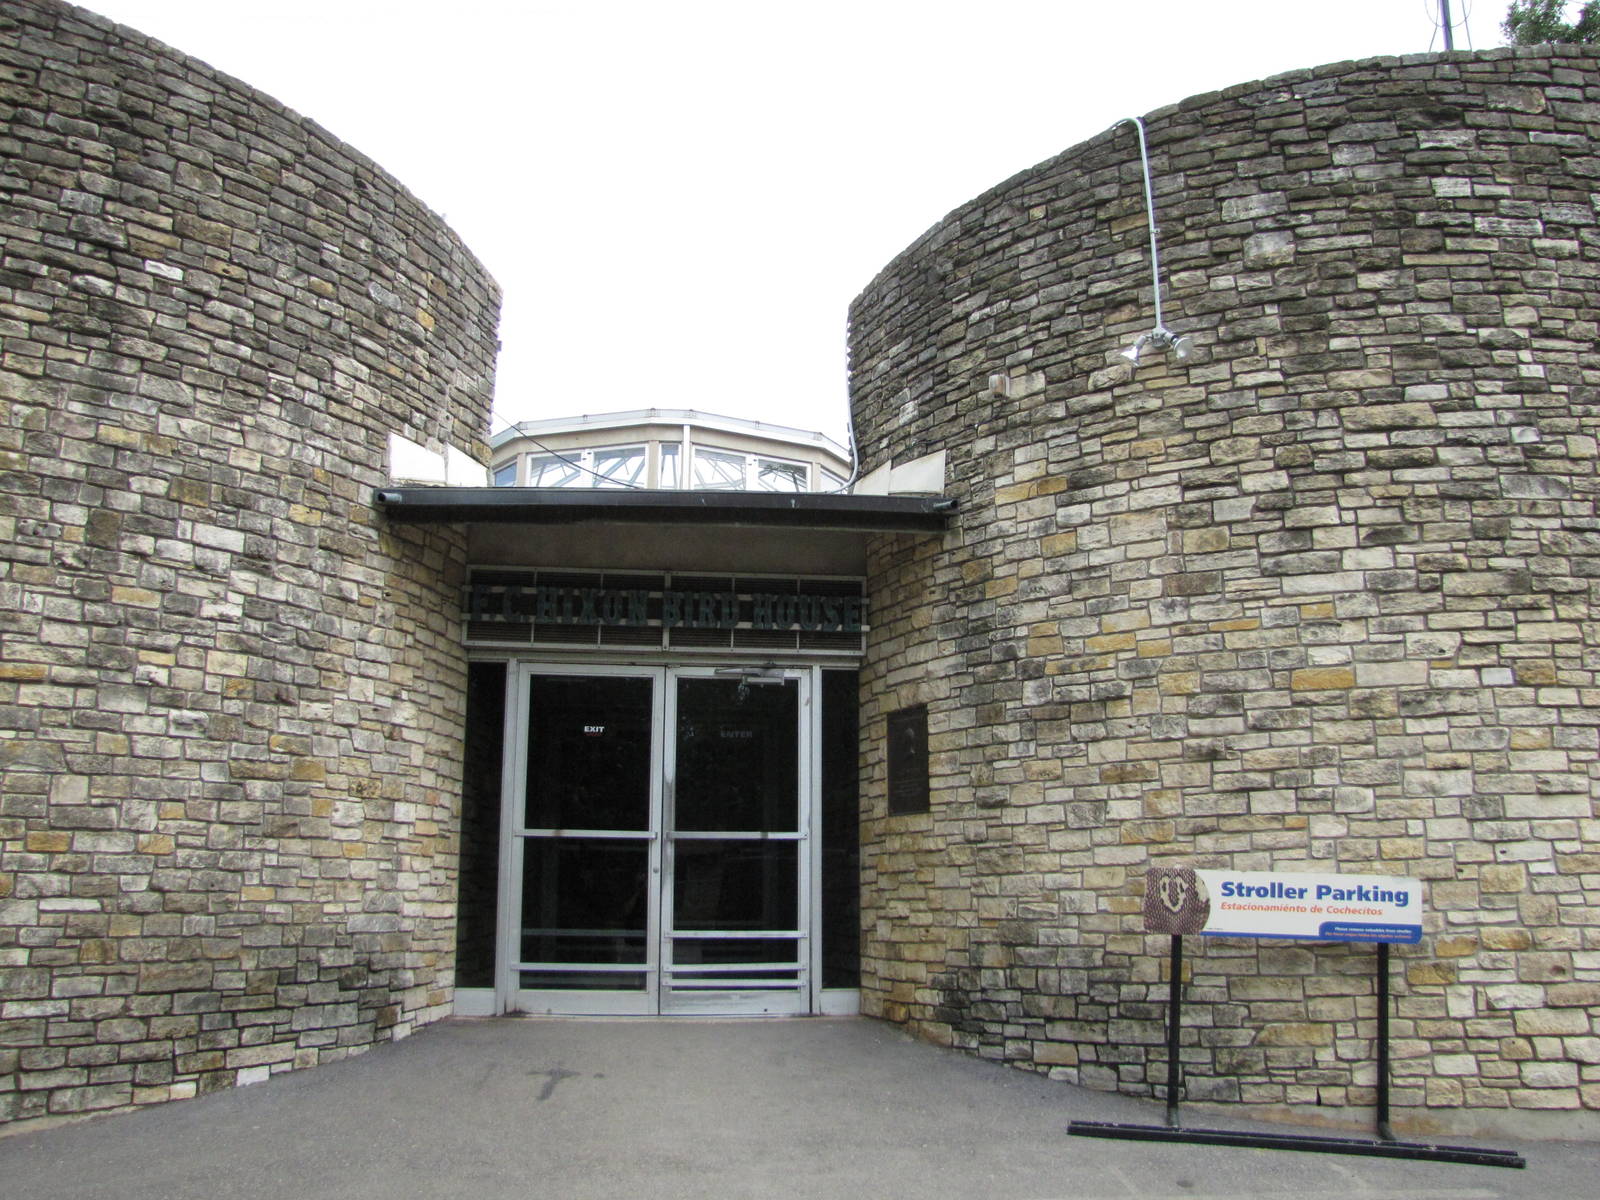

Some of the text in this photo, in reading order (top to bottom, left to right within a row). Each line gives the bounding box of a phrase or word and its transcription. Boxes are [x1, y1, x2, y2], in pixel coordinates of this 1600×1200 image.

[536, 584, 648, 627] HIXON
[661, 590, 739, 629] BIRD
[751, 592, 861, 632] HOUSE
[583, 725, 605, 733] EXIT
[720, 729, 753, 738] ENTER
[1220, 881, 1409, 907] Stroller Parking
[1310, 904, 1323, 914] de
[1326, 905, 1383, 916] Cochecitos
